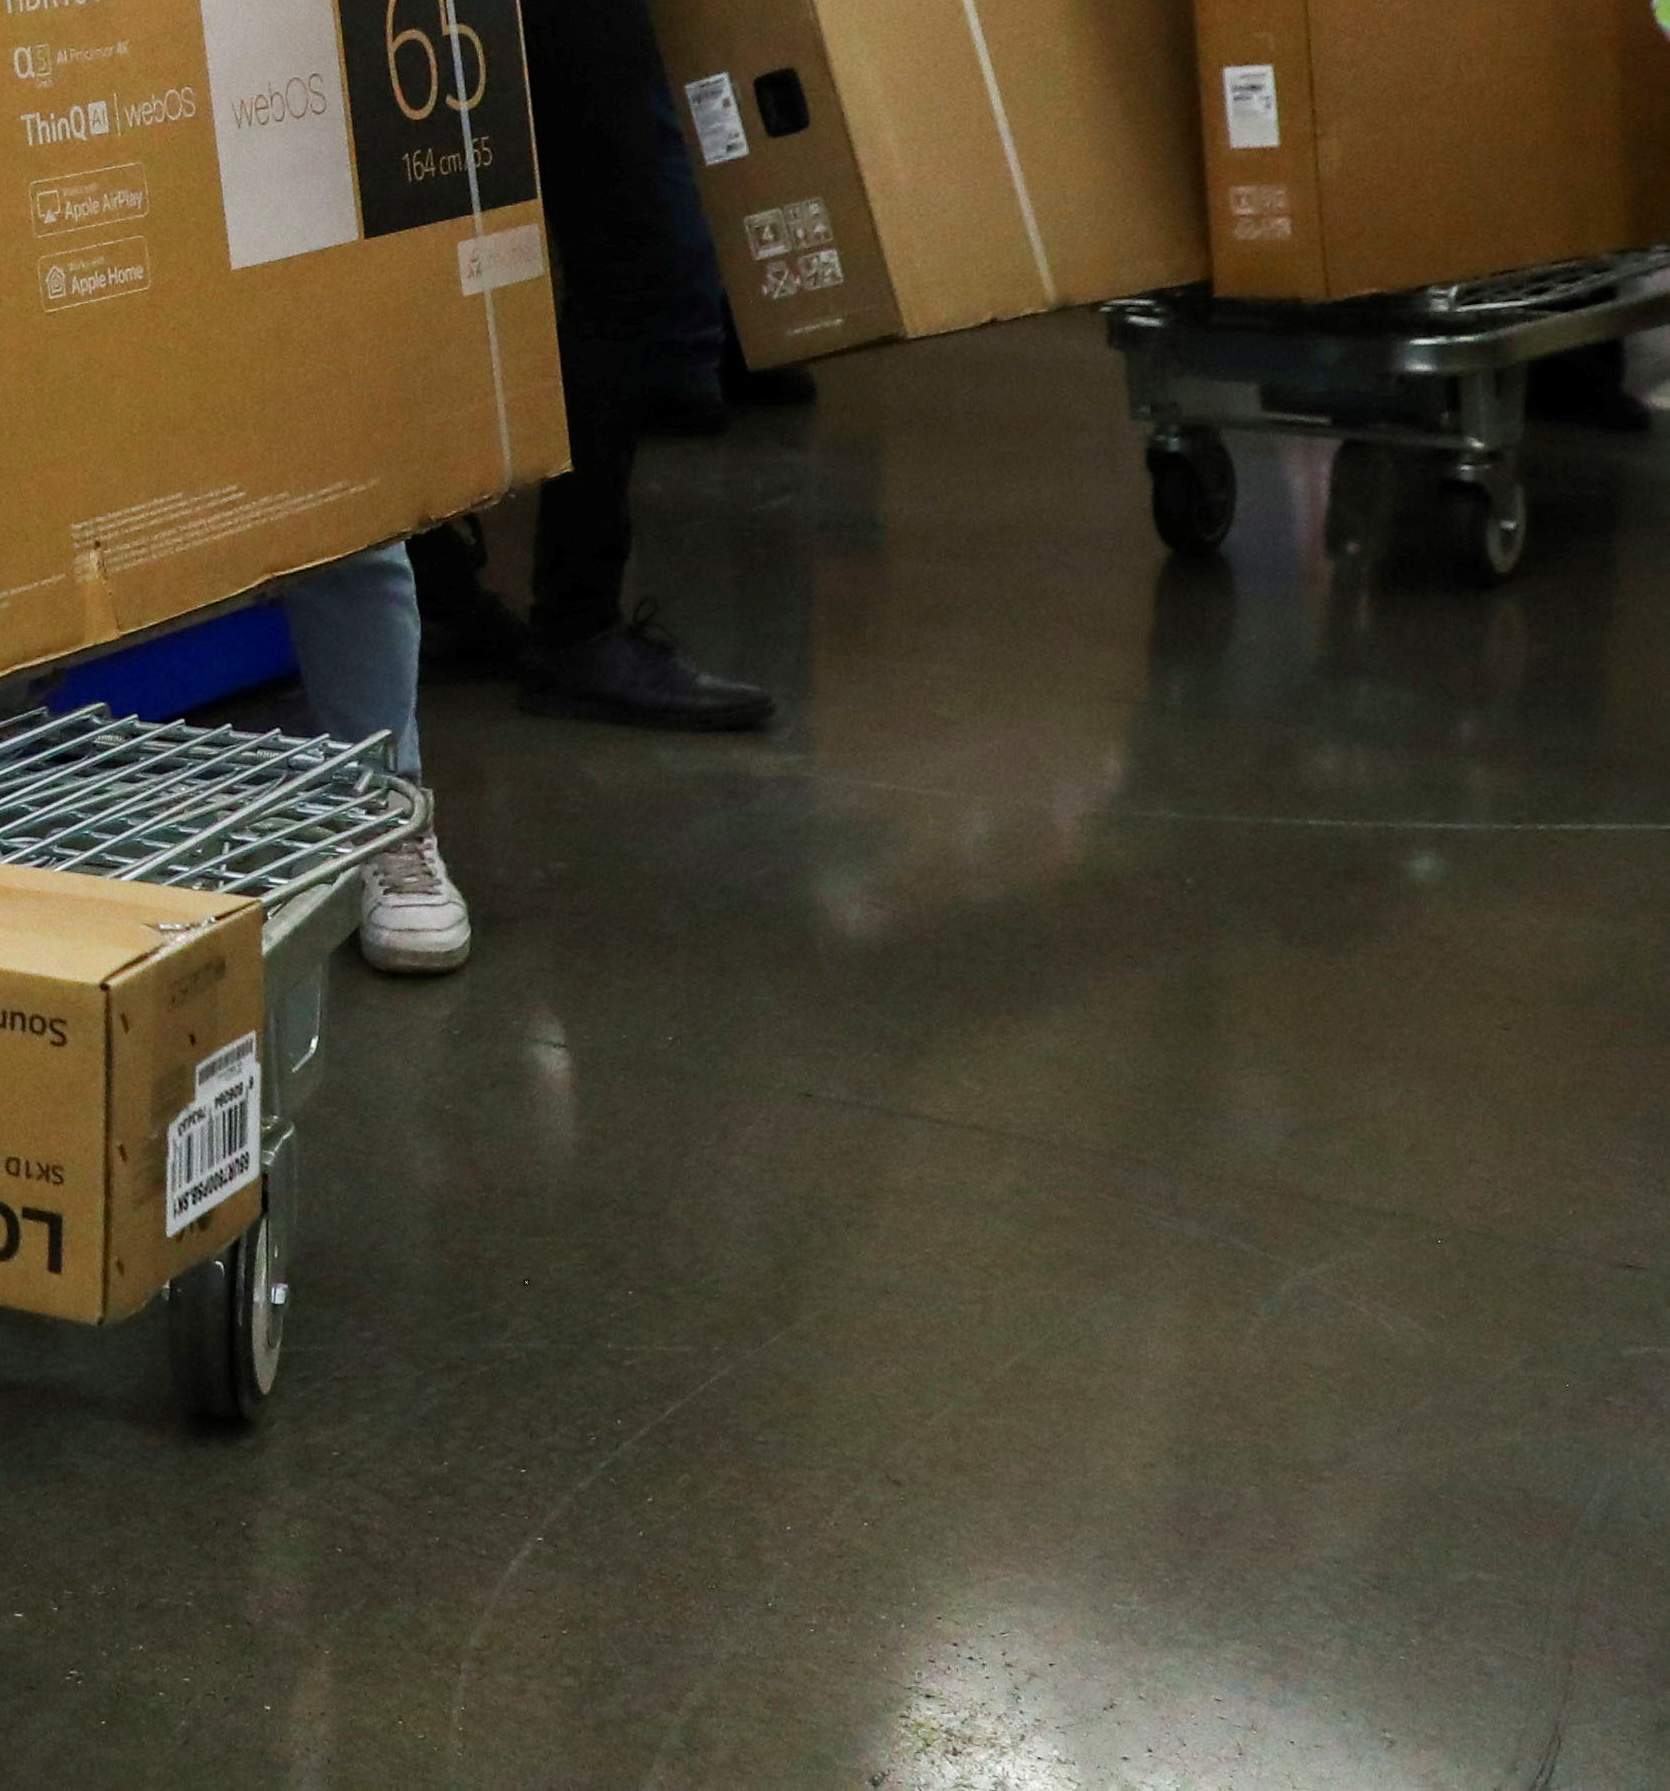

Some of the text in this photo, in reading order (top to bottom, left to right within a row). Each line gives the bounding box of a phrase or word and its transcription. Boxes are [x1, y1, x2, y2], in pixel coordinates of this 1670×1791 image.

[20, 105, 88, 146] ThinQ
[124, 86, 196, 128] webOS
[230, 73, 327, 129] webOS
[402, 148, 437, 183] 164
[65, 196, 100, 223] Apple
[102, 189, 143, 213] AirPlay
[71, 265, 144, 296] Apple Home
[5, 1156, 63, 1185] SK1D
